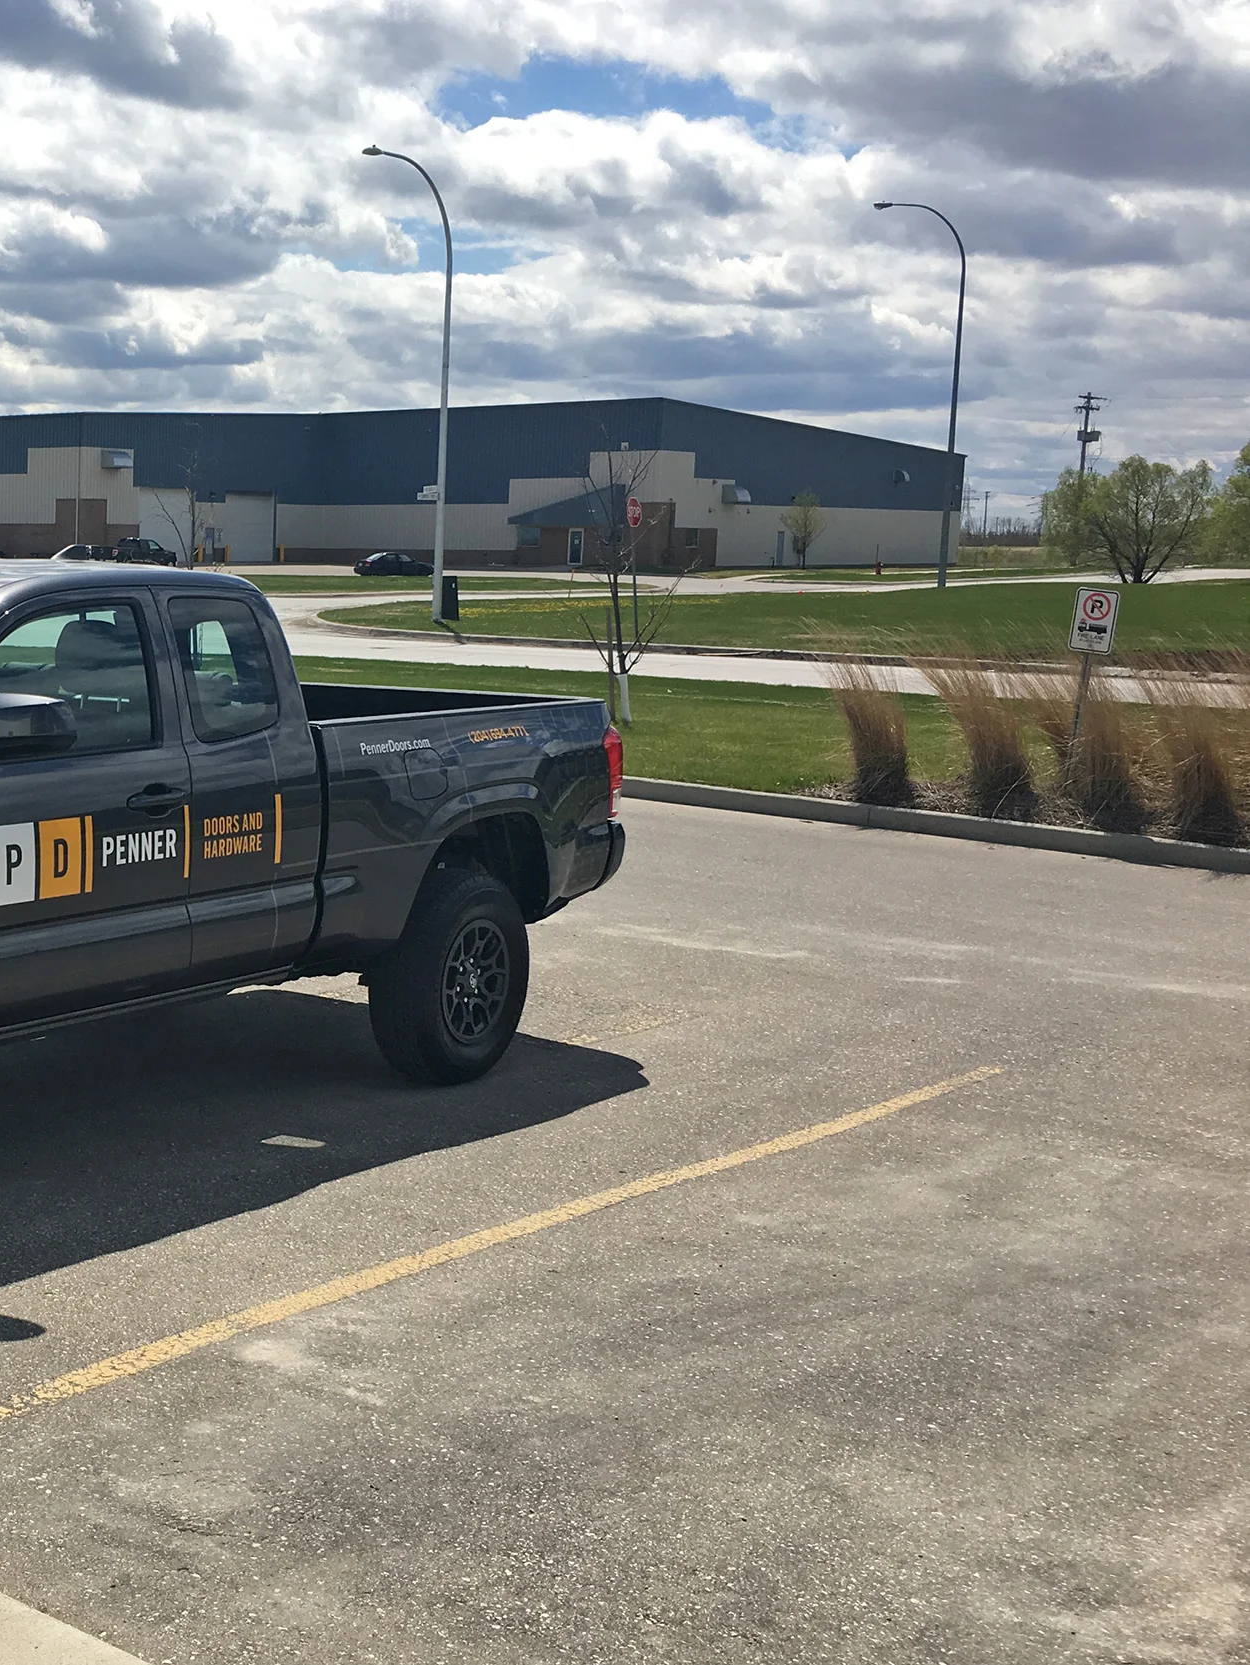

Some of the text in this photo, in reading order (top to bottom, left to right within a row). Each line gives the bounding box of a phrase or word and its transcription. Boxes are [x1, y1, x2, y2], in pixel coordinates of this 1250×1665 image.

[628, 506, 641, 517] STOP
[359, 738, 432, 756] PennerDoors.com
[203, 811, 263, 837] DOORS AND
[102, 828, 177, 868] PENNER
[203, 833, 263, 860] HARDWARE
[5, 838, 69, 886] P D
